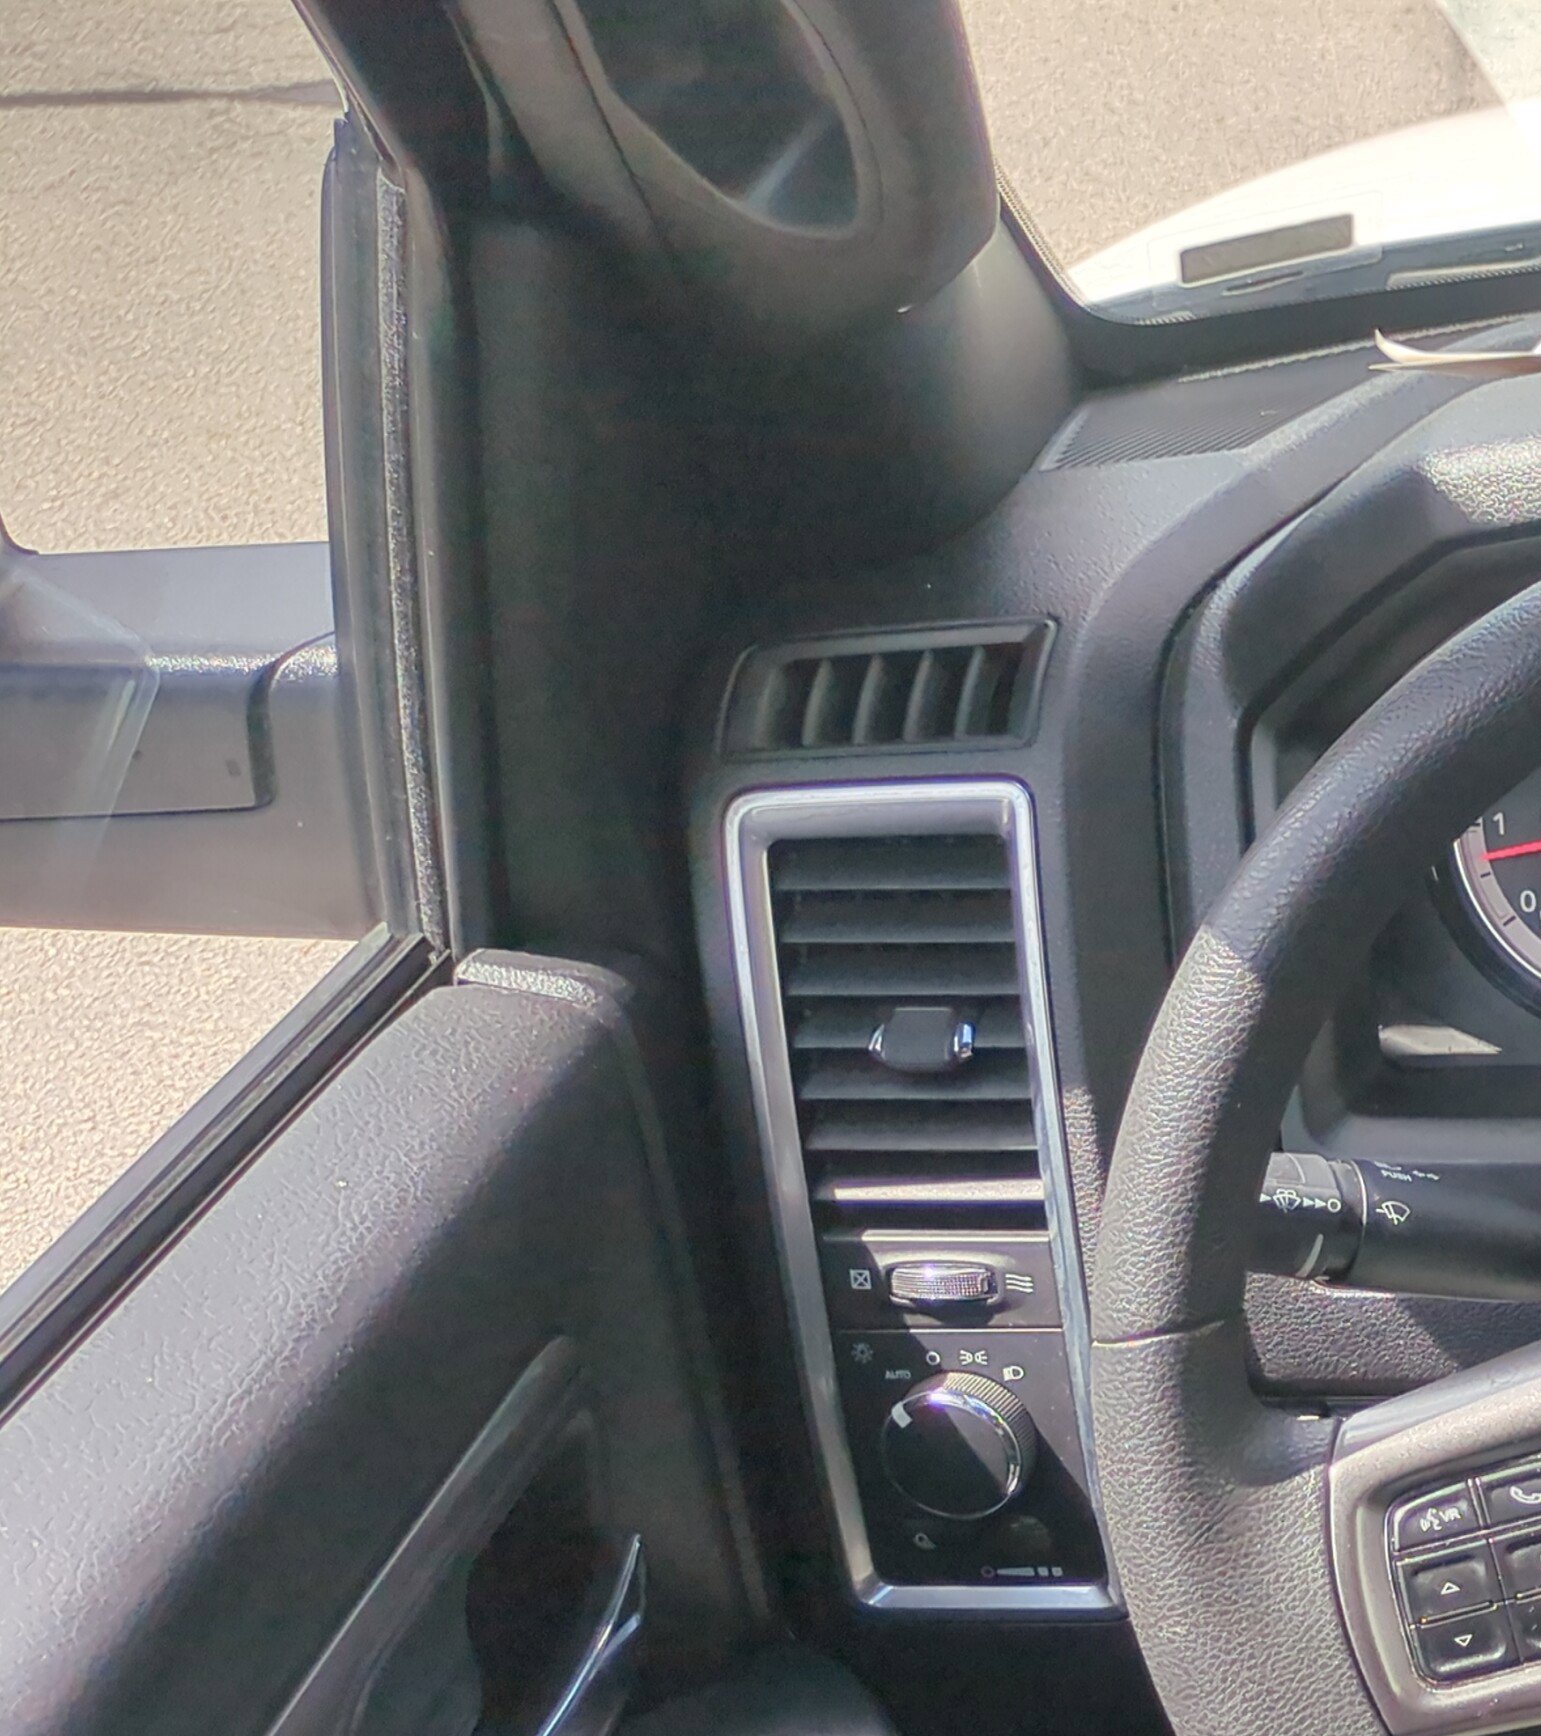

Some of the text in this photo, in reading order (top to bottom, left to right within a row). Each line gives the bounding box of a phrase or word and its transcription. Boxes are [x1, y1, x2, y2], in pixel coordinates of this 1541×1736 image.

[1492, 812, 1506, 836] 1
[1520, 890, 1537, 913] 0
[885, 1370, 911, 1380] AUTO
